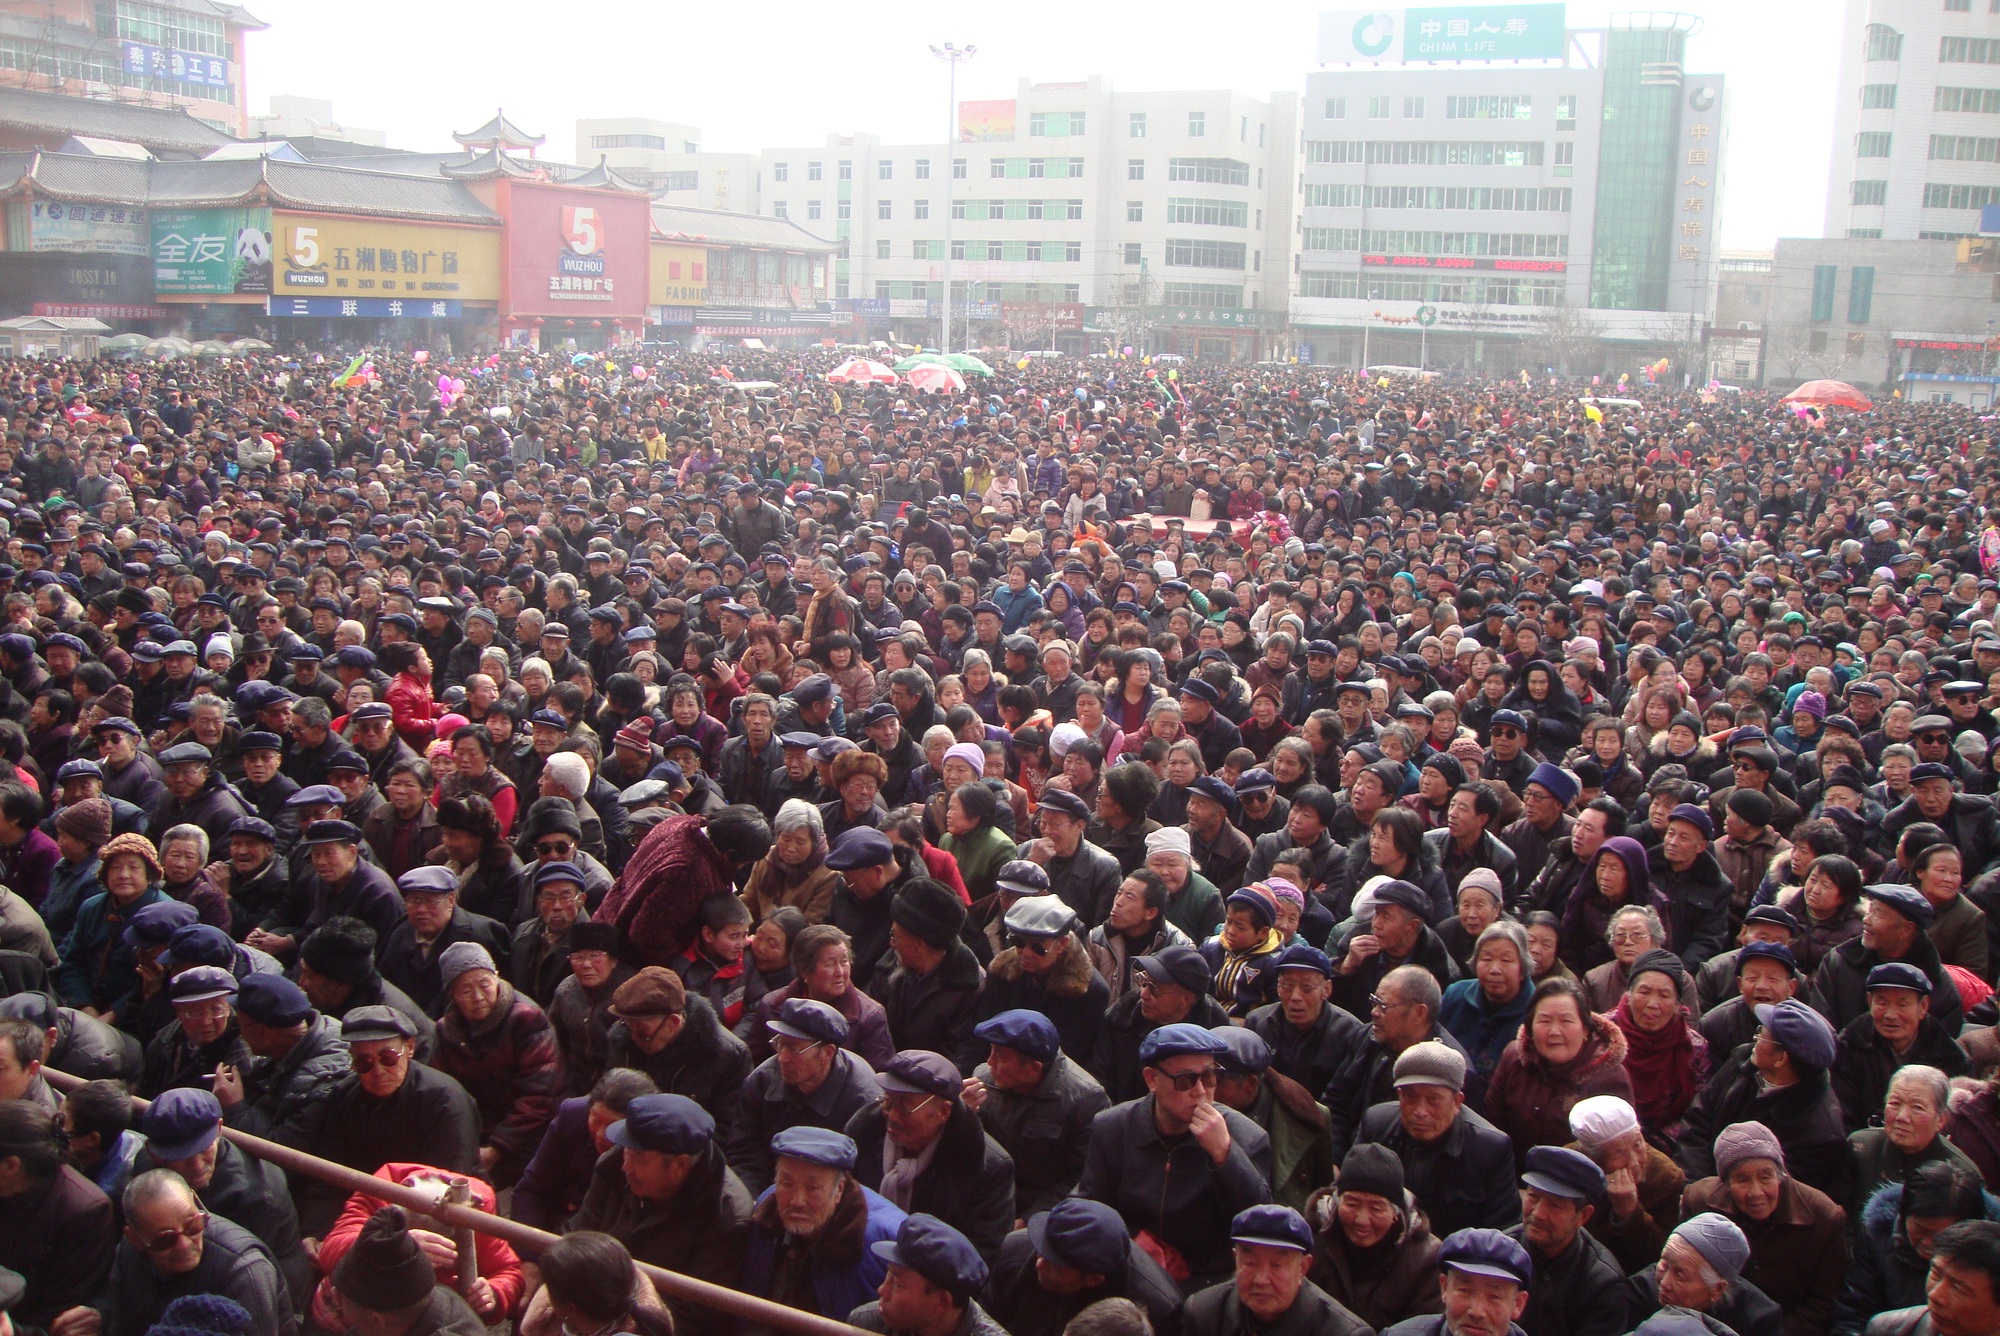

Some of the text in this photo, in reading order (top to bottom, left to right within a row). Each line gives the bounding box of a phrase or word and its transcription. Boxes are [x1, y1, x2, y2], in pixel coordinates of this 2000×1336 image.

[1420, 17, 1529, 38] 中国人寿
[1419, 40, 1496, 53] CHINA LIFE
[1679, 123, 1710, 261] 中国人寿保险
[69, 206, 145, 224] 圆通速递
[571, 207, 596, 255] 5
[155, 233, 227, 262] 全友
[294, 227, 319, 267] 5
[333, 247, 459, 274] 五洲购物广场
[563, 259, 603, 272] WUZHOU
[104, 270, 117, 286] JO
[290, 274, 325, 284] WUZHOU
[336, 277, 348, 288] WU
[358, 279, 375, 289] ZHOU
[382, 280, 396, 289] GOU
[550, 276, 614, 292] 五洲购物广场
[292, 299, 447, 317] 三联书城
